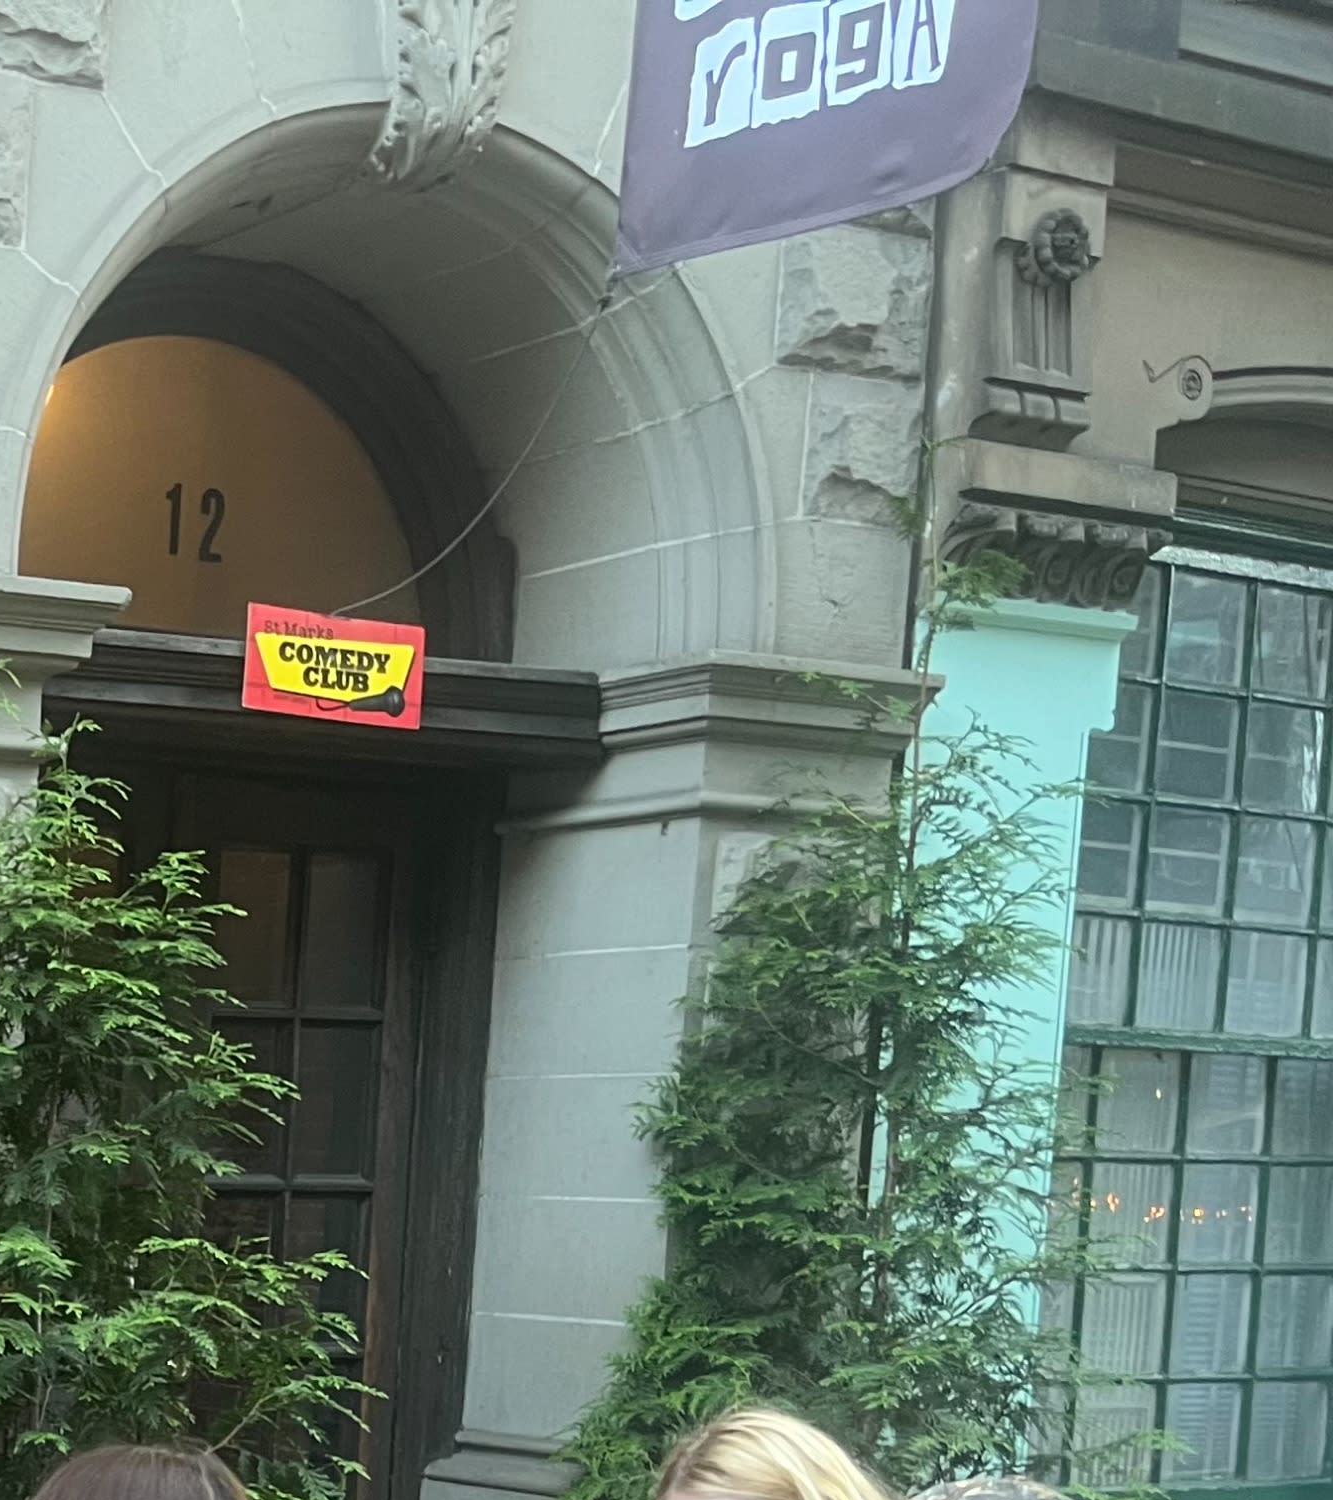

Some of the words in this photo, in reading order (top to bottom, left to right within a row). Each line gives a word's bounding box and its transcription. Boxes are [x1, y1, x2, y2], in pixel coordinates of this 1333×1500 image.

[164, 482, 226, 563] 12
[284, 621, 334, 640] Marks
[278, 640, 391, 674] COMEDY
[302, 666, 370, 693] CLUB
